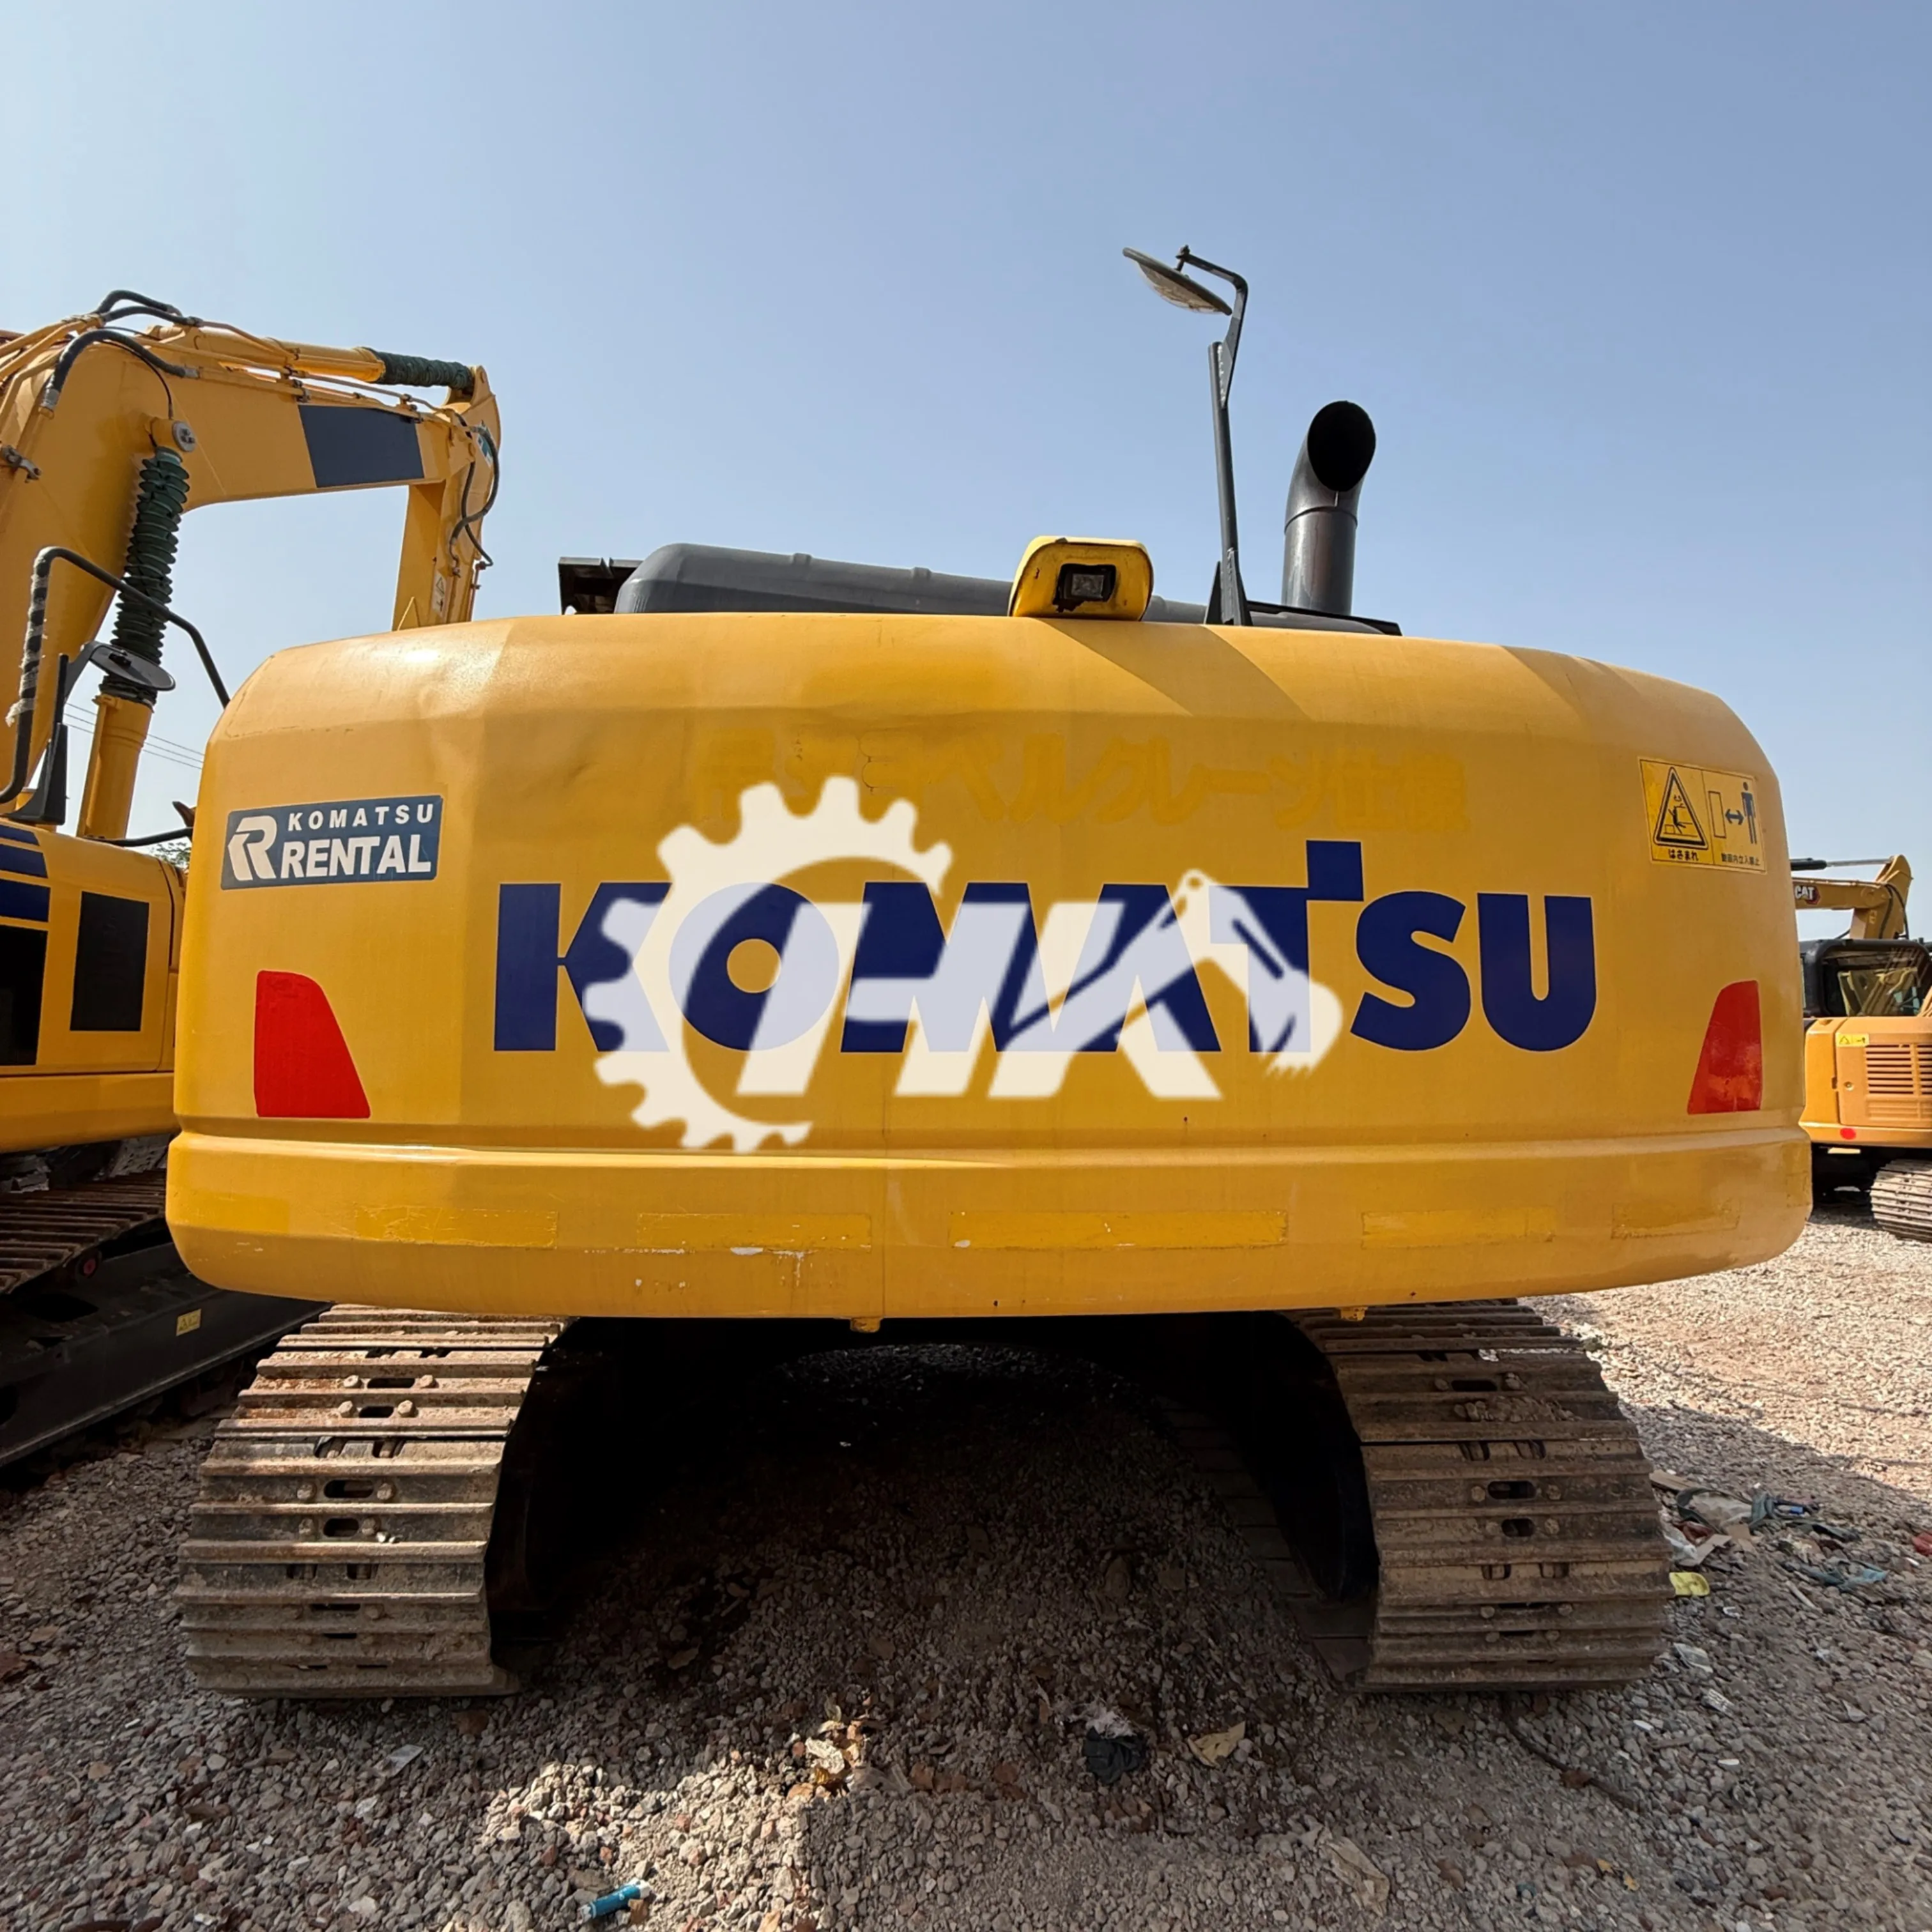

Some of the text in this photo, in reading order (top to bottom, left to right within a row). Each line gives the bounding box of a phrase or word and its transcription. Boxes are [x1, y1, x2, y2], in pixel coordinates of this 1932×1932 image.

[288, 804, 433, 831] KOMATSU
[280, 834, 432, 878] RENTAL
[1795, 885, 1815, 900] CAT
[494, 841, 1597, 1052] KOMATSU
